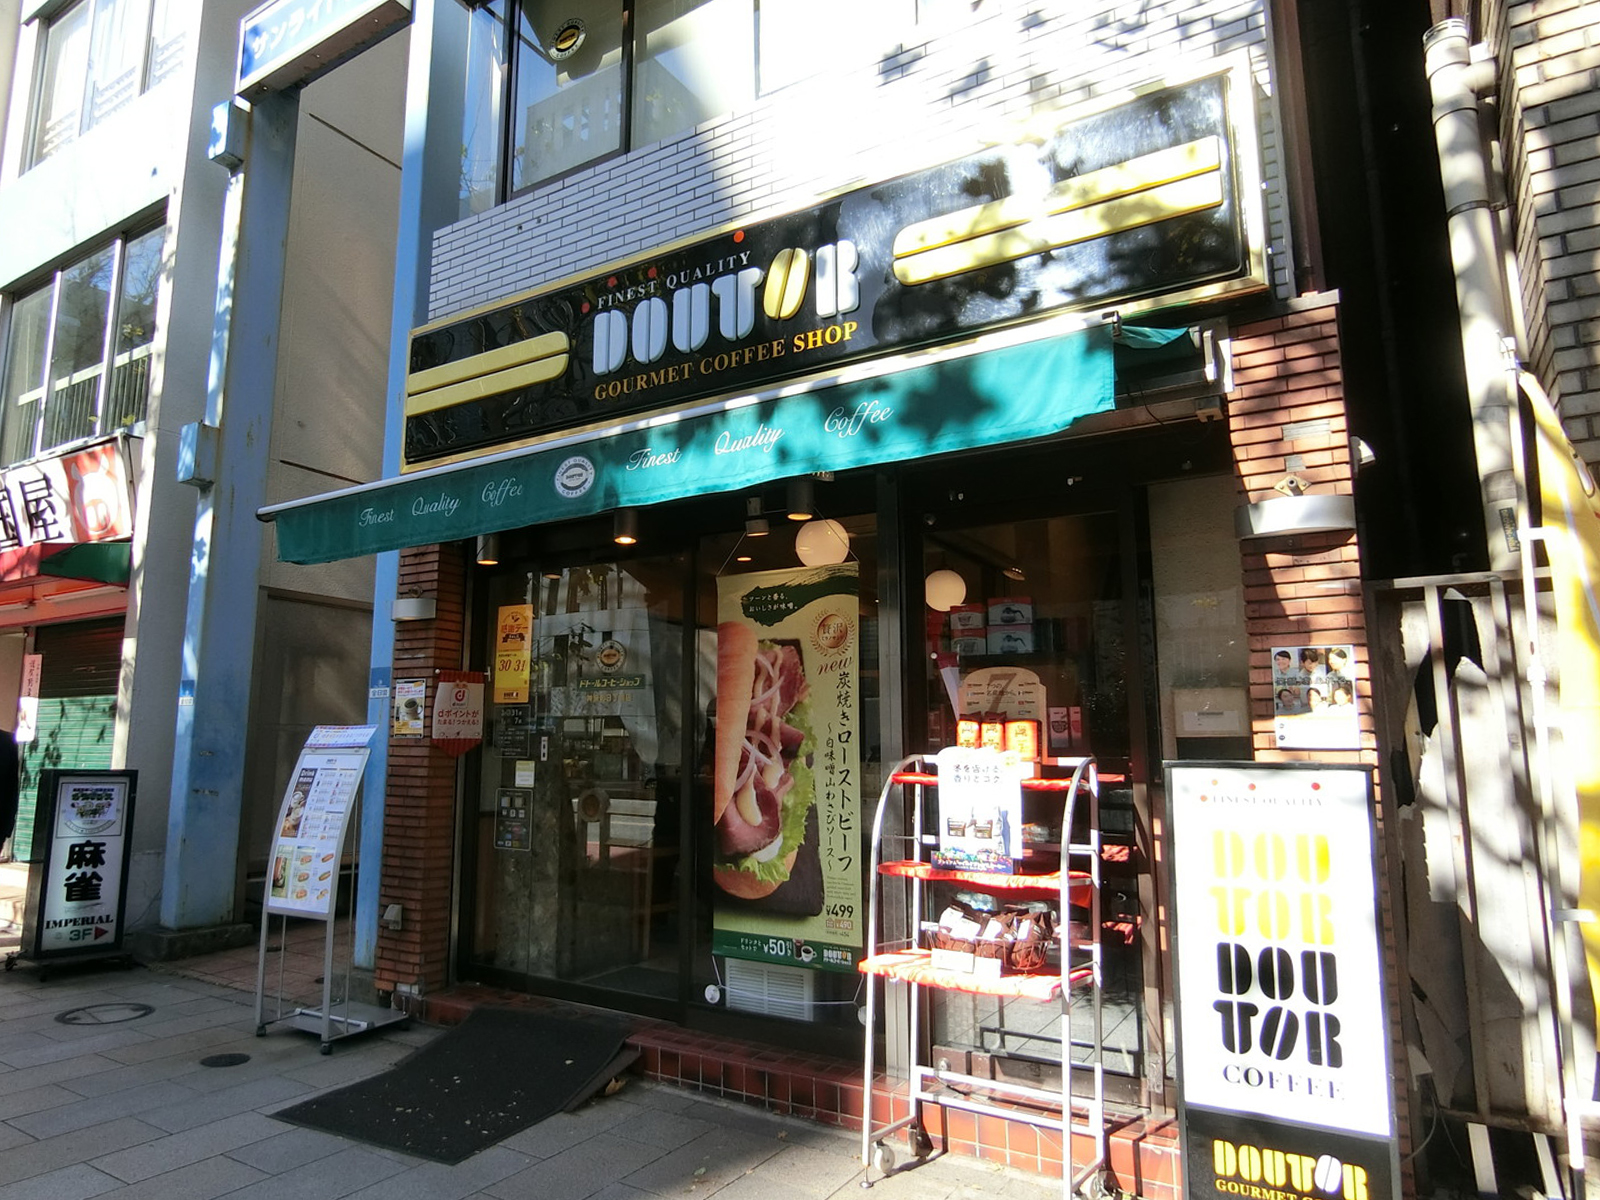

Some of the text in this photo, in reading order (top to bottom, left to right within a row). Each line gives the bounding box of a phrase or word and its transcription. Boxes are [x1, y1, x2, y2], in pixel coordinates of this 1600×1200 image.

[592, 240, 861, 377] DOUTOR
[597, 250, 751, 309] FINEST QUALITY
[594, 321, 859, 400] GOURMET COFFEE SHOP
[626, 399, 895, 472] Finest Quality Coffee
[358, 478, 523, 528] Finest Quality Coffee
[499, 659, 526, 671] 30 31
[817, 657, 853, 676] new
[438, 710, 479, 718] dポイントが
[836, 671, 853, 872] 炭焼きローストビーフ
[64, 840, 107, 903] 麻雀
[45, 914, 114, 930] IMPERIAL
[69, 928, 93, 942] 3F
[1216, 942, 1339, 1006] DOU
[1212, 1000, 1344, 1070] TOR
[1223, 1063, 1346, 1100] COFFEE
[1212, 1139, 1368, 1200] DOUTOR
[1215, 1179, 1298, 1200] GOURMET
